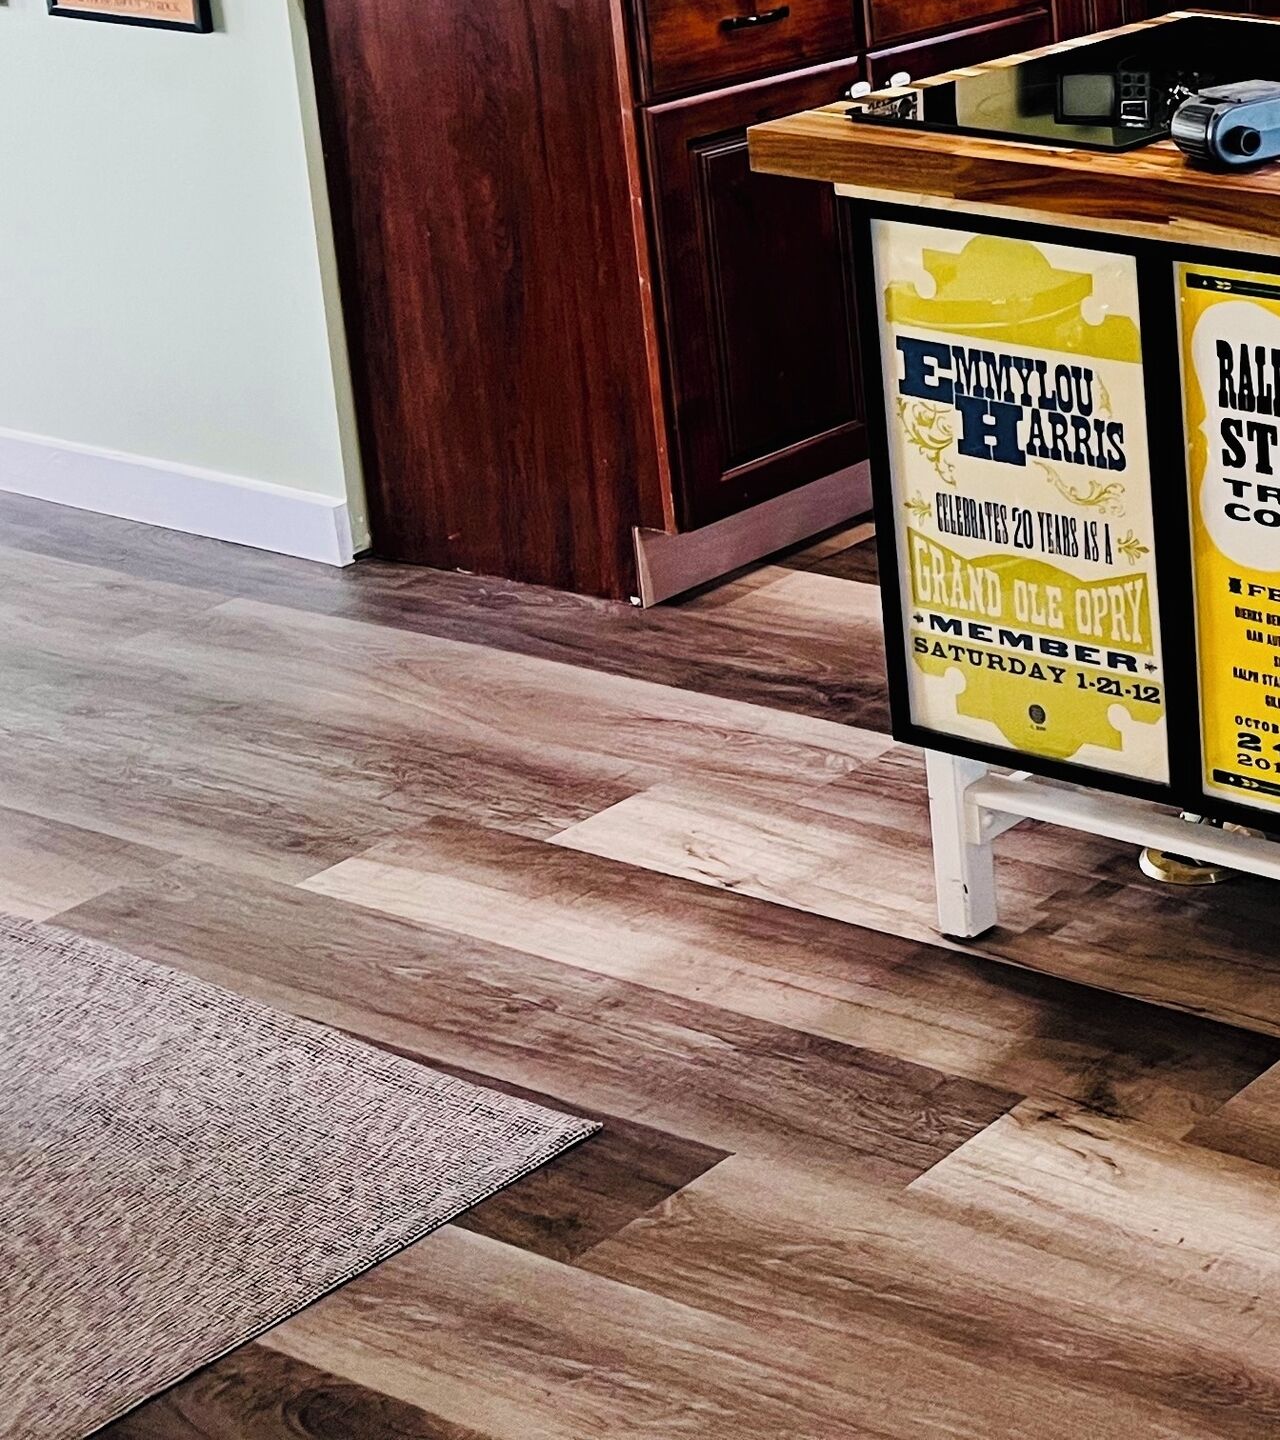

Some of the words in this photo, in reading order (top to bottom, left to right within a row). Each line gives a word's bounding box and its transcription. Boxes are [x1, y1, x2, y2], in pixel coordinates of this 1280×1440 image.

[896, 336, 1093, 416] EMMYLOU
[954, 393, 1126, 472] HARRIS
[936, 492, 1009, 544] CELEBRATES
[1012, 508, 1033, 549] 20
[1038, 511, 1079, 557] YEARS
[1084, 521, 1099, 561] AS
[1104, 523, 1113, 564] A
[914, 539, 1002, 617] GRAND
[1014, 578, 1065, 629] OLE
[1075, 580, 1145, 645] OPRY
[913, 637, 1066, 684] SATURDAY
[1077, 672, 1161, 704] 1-21-12
[929, 613, 1138, 673] MEMBER
[1233, 667, 1259, 683] RALPH
